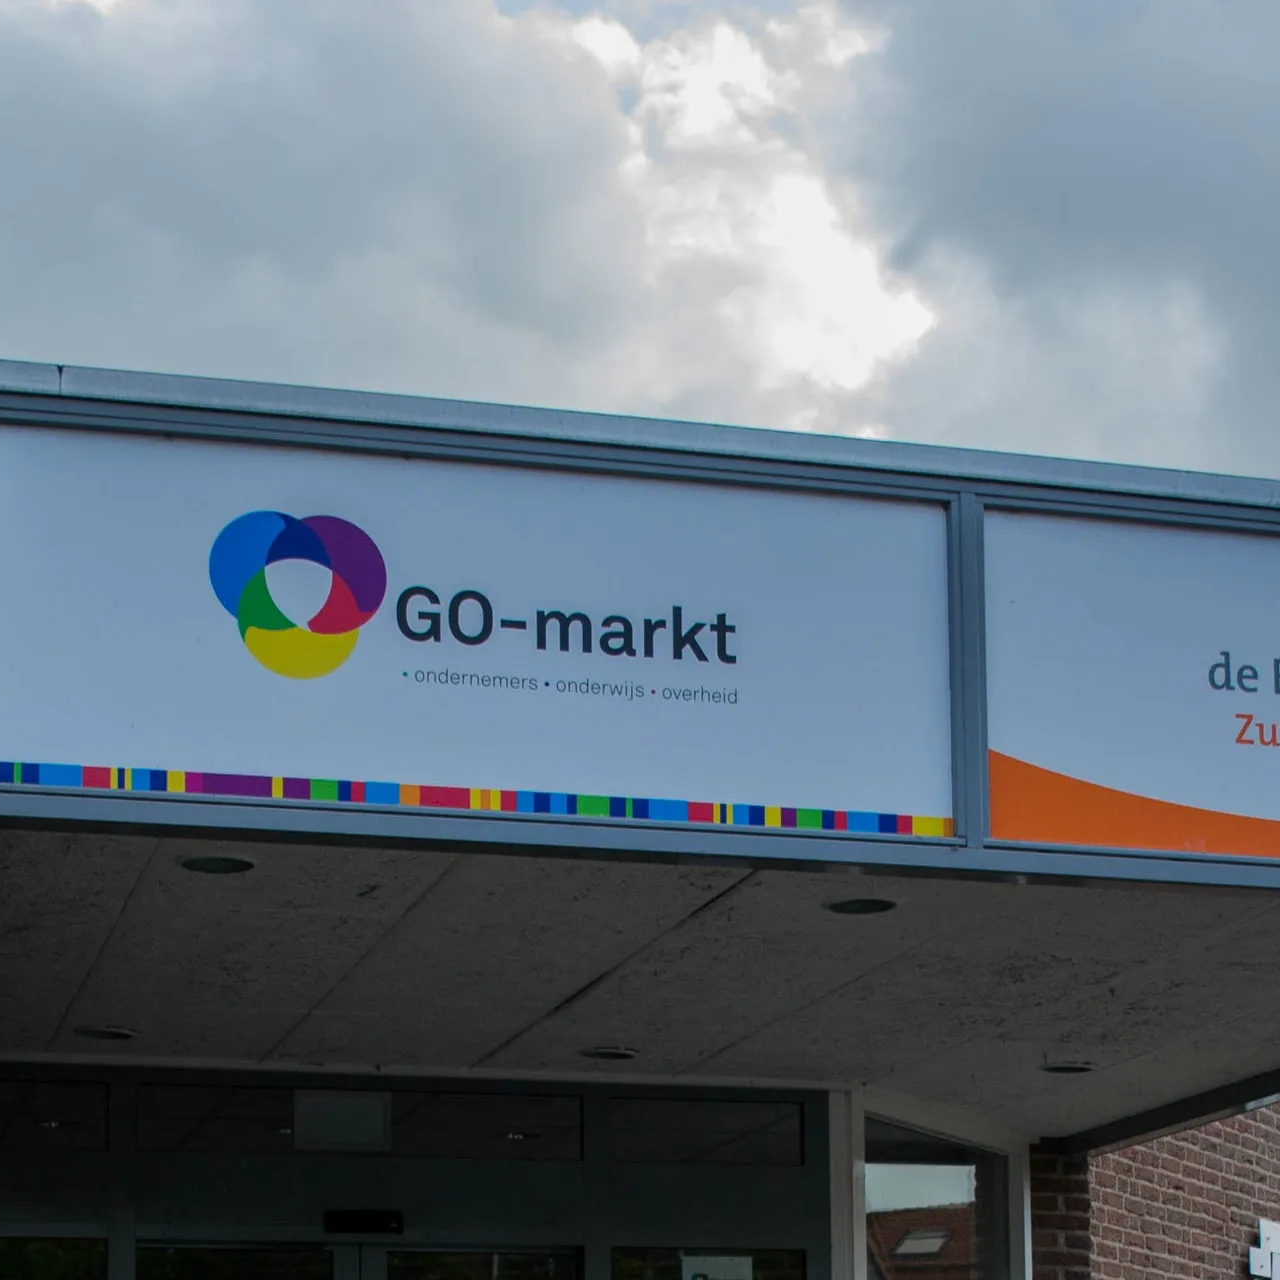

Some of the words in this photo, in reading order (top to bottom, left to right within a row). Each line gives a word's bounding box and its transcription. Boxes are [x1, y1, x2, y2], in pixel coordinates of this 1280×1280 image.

[395, 585, 738, 665] GO-markt
[414, 668, 539, 691] ondernemers
[556, 678, 645, 701] onderwijs
[661, 685, 739, 706] overheid
[1207, 651, 1260, 694] de
